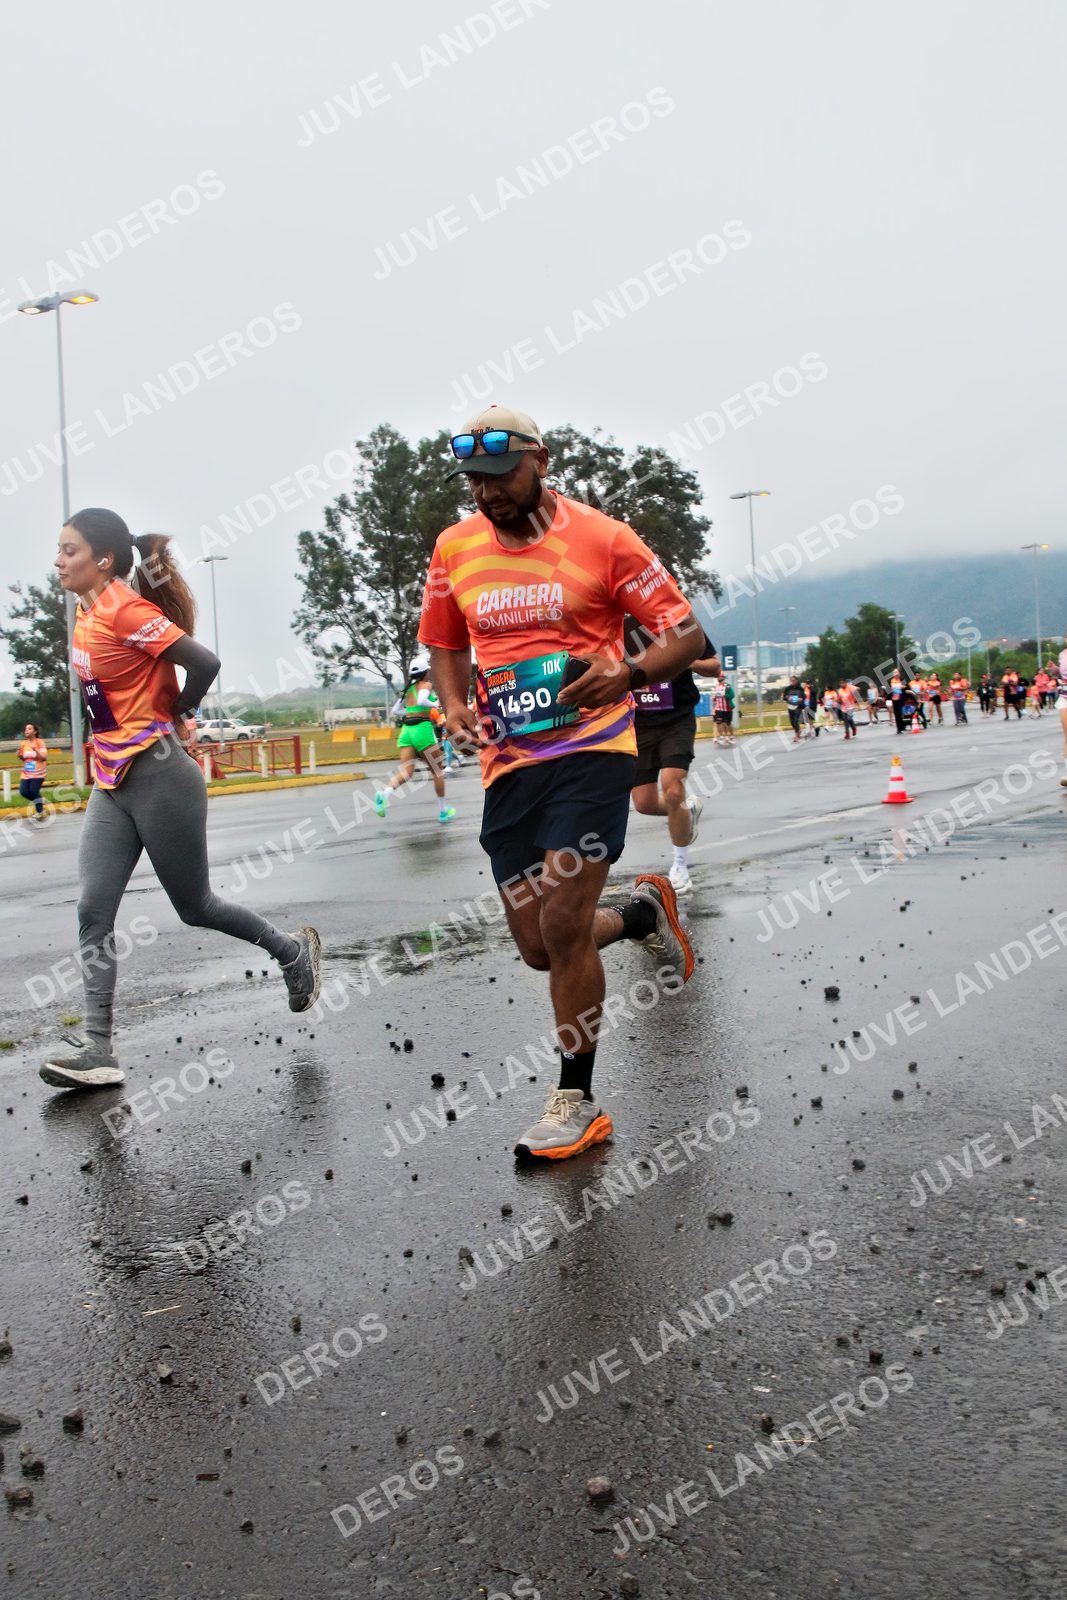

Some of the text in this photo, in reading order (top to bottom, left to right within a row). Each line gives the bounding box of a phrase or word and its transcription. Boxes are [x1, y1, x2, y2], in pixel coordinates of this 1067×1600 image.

[476, 582, 563, 616] CARRERA
[478, 608, 545, 630] OMNILIFE
[541, 658, 562, 676] 10K
[724, 656, 734, 668] E
[85, 684, 99, 697] 15K
[640, 693, 660, 703] 664
[497, 687, 552, 718] 1490
